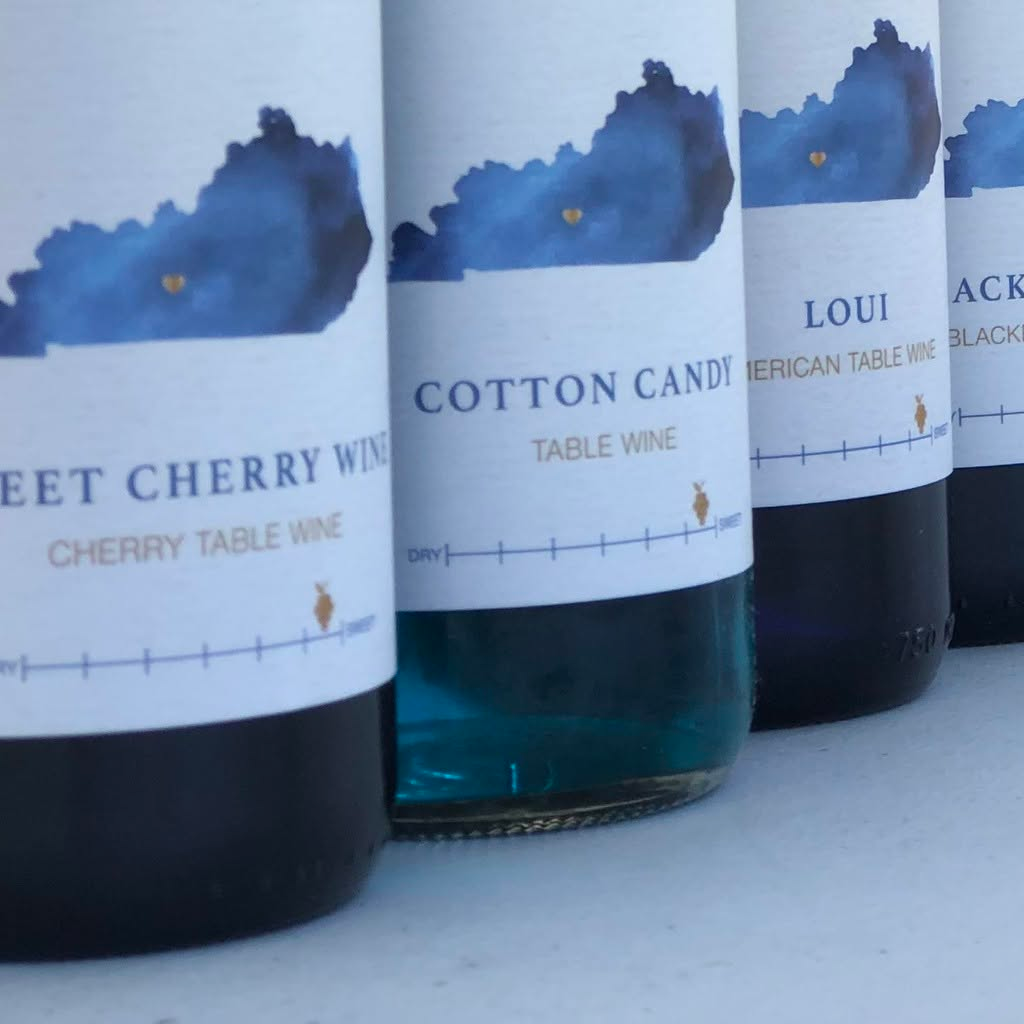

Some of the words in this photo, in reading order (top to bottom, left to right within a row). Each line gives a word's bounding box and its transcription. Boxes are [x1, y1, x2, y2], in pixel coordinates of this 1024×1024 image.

[804, 293, 889, 329] LOUI
[848, 345, 903, 372] TABLE
[906, 338, 937, 364] WINE
[413, 371, 618, 414] COTTON
[634, 354, 734, 400] CANDY
[531, 434, 613, 462] TABLE
[620, 427, 679, 455] WINE
[126, 446, 321, 502] CHERRY
[333, 430, 388, 477] WINE
[48, 533, 184, 568] CHERRY
[195, 522, 281, 557] TABLE
[287, 511, 344, 544] WINE
[407, 547, 443, 564] DRY
